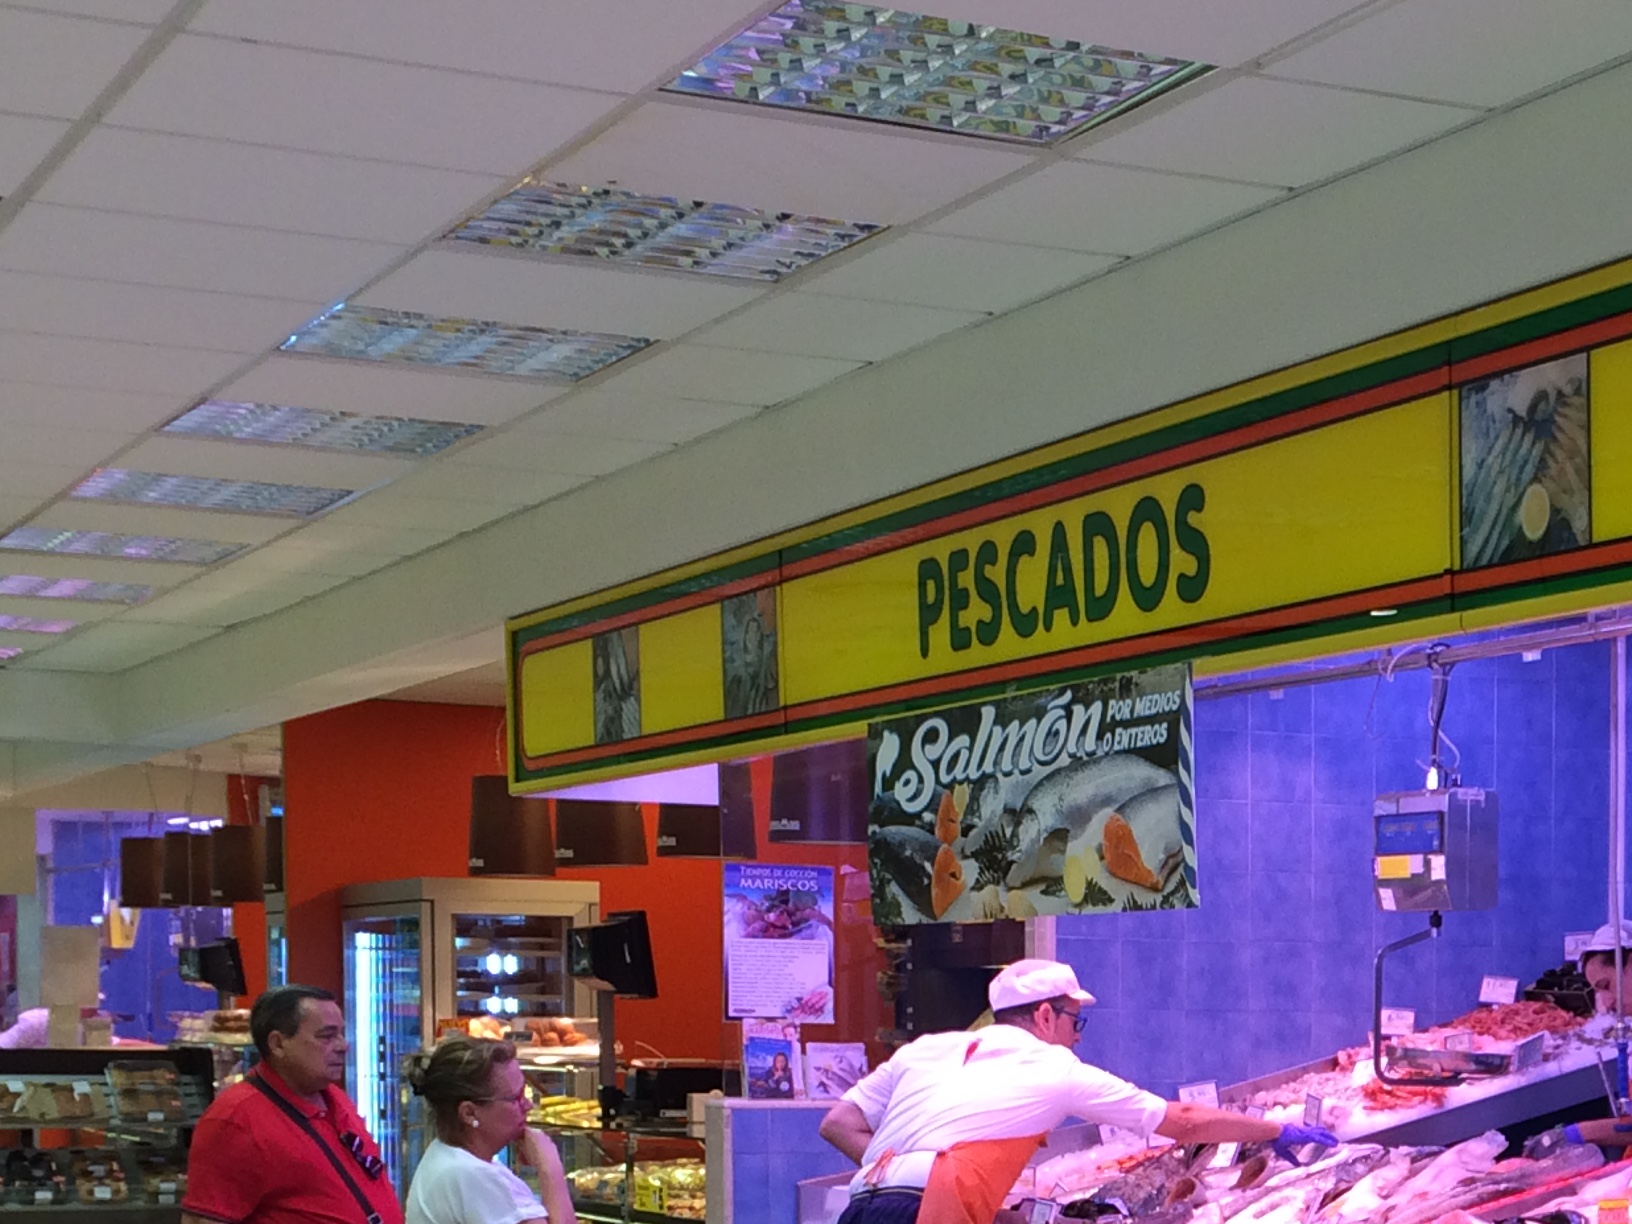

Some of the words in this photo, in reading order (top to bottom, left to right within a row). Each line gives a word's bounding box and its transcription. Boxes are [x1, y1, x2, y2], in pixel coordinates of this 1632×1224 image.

[917, 483, 1211, 659] PESCADOS
[895, 689, 1102, 814] Salmón
[1106, 699, 1132, 723] POR
[1134, 690, 1180, 718] MEDIOS
[1113, 722, 1168, 751] ENTEROS
[740, 878, 818, 891] MARISCOS
